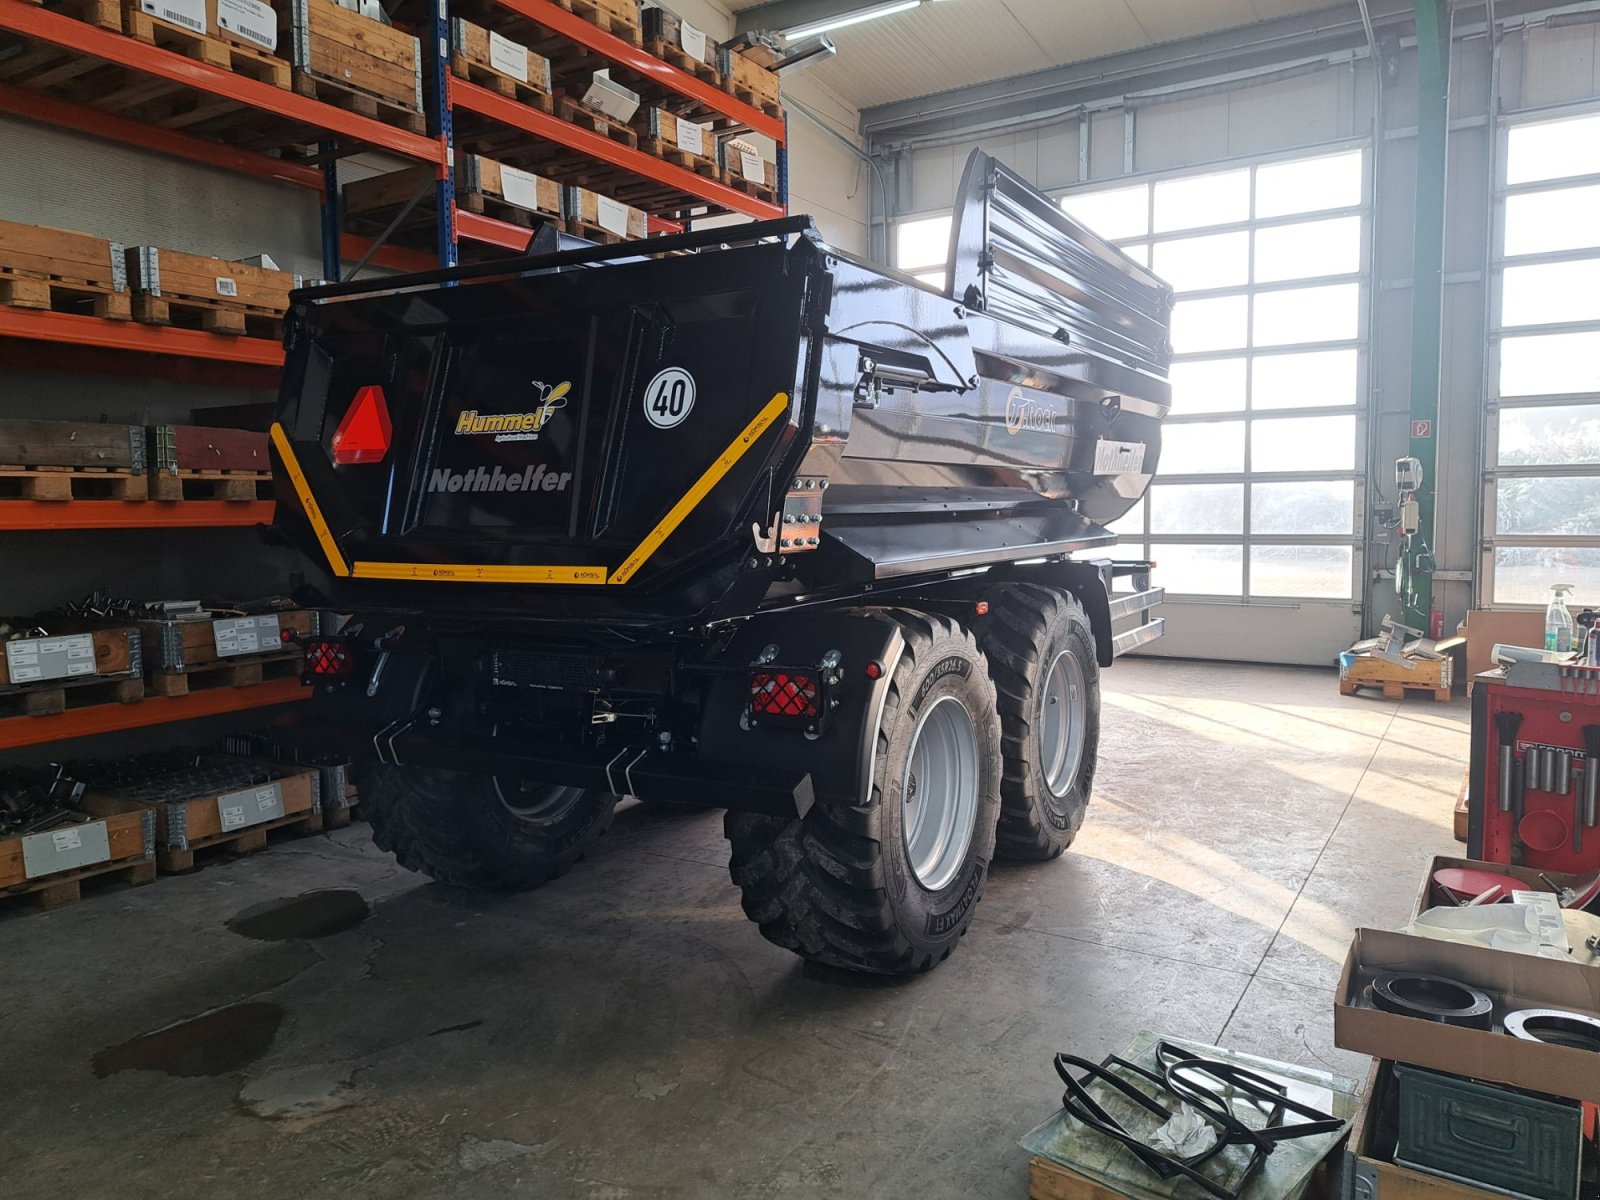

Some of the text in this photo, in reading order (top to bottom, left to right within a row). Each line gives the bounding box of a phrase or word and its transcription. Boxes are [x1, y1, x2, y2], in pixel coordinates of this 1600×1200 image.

[652, 379, 686, 417] 40
[455, 407, 542, 434] Hummel
[428, 464, 572, 493] Nothhelfer
[946, 872, 980, 929] FLOATMAX
